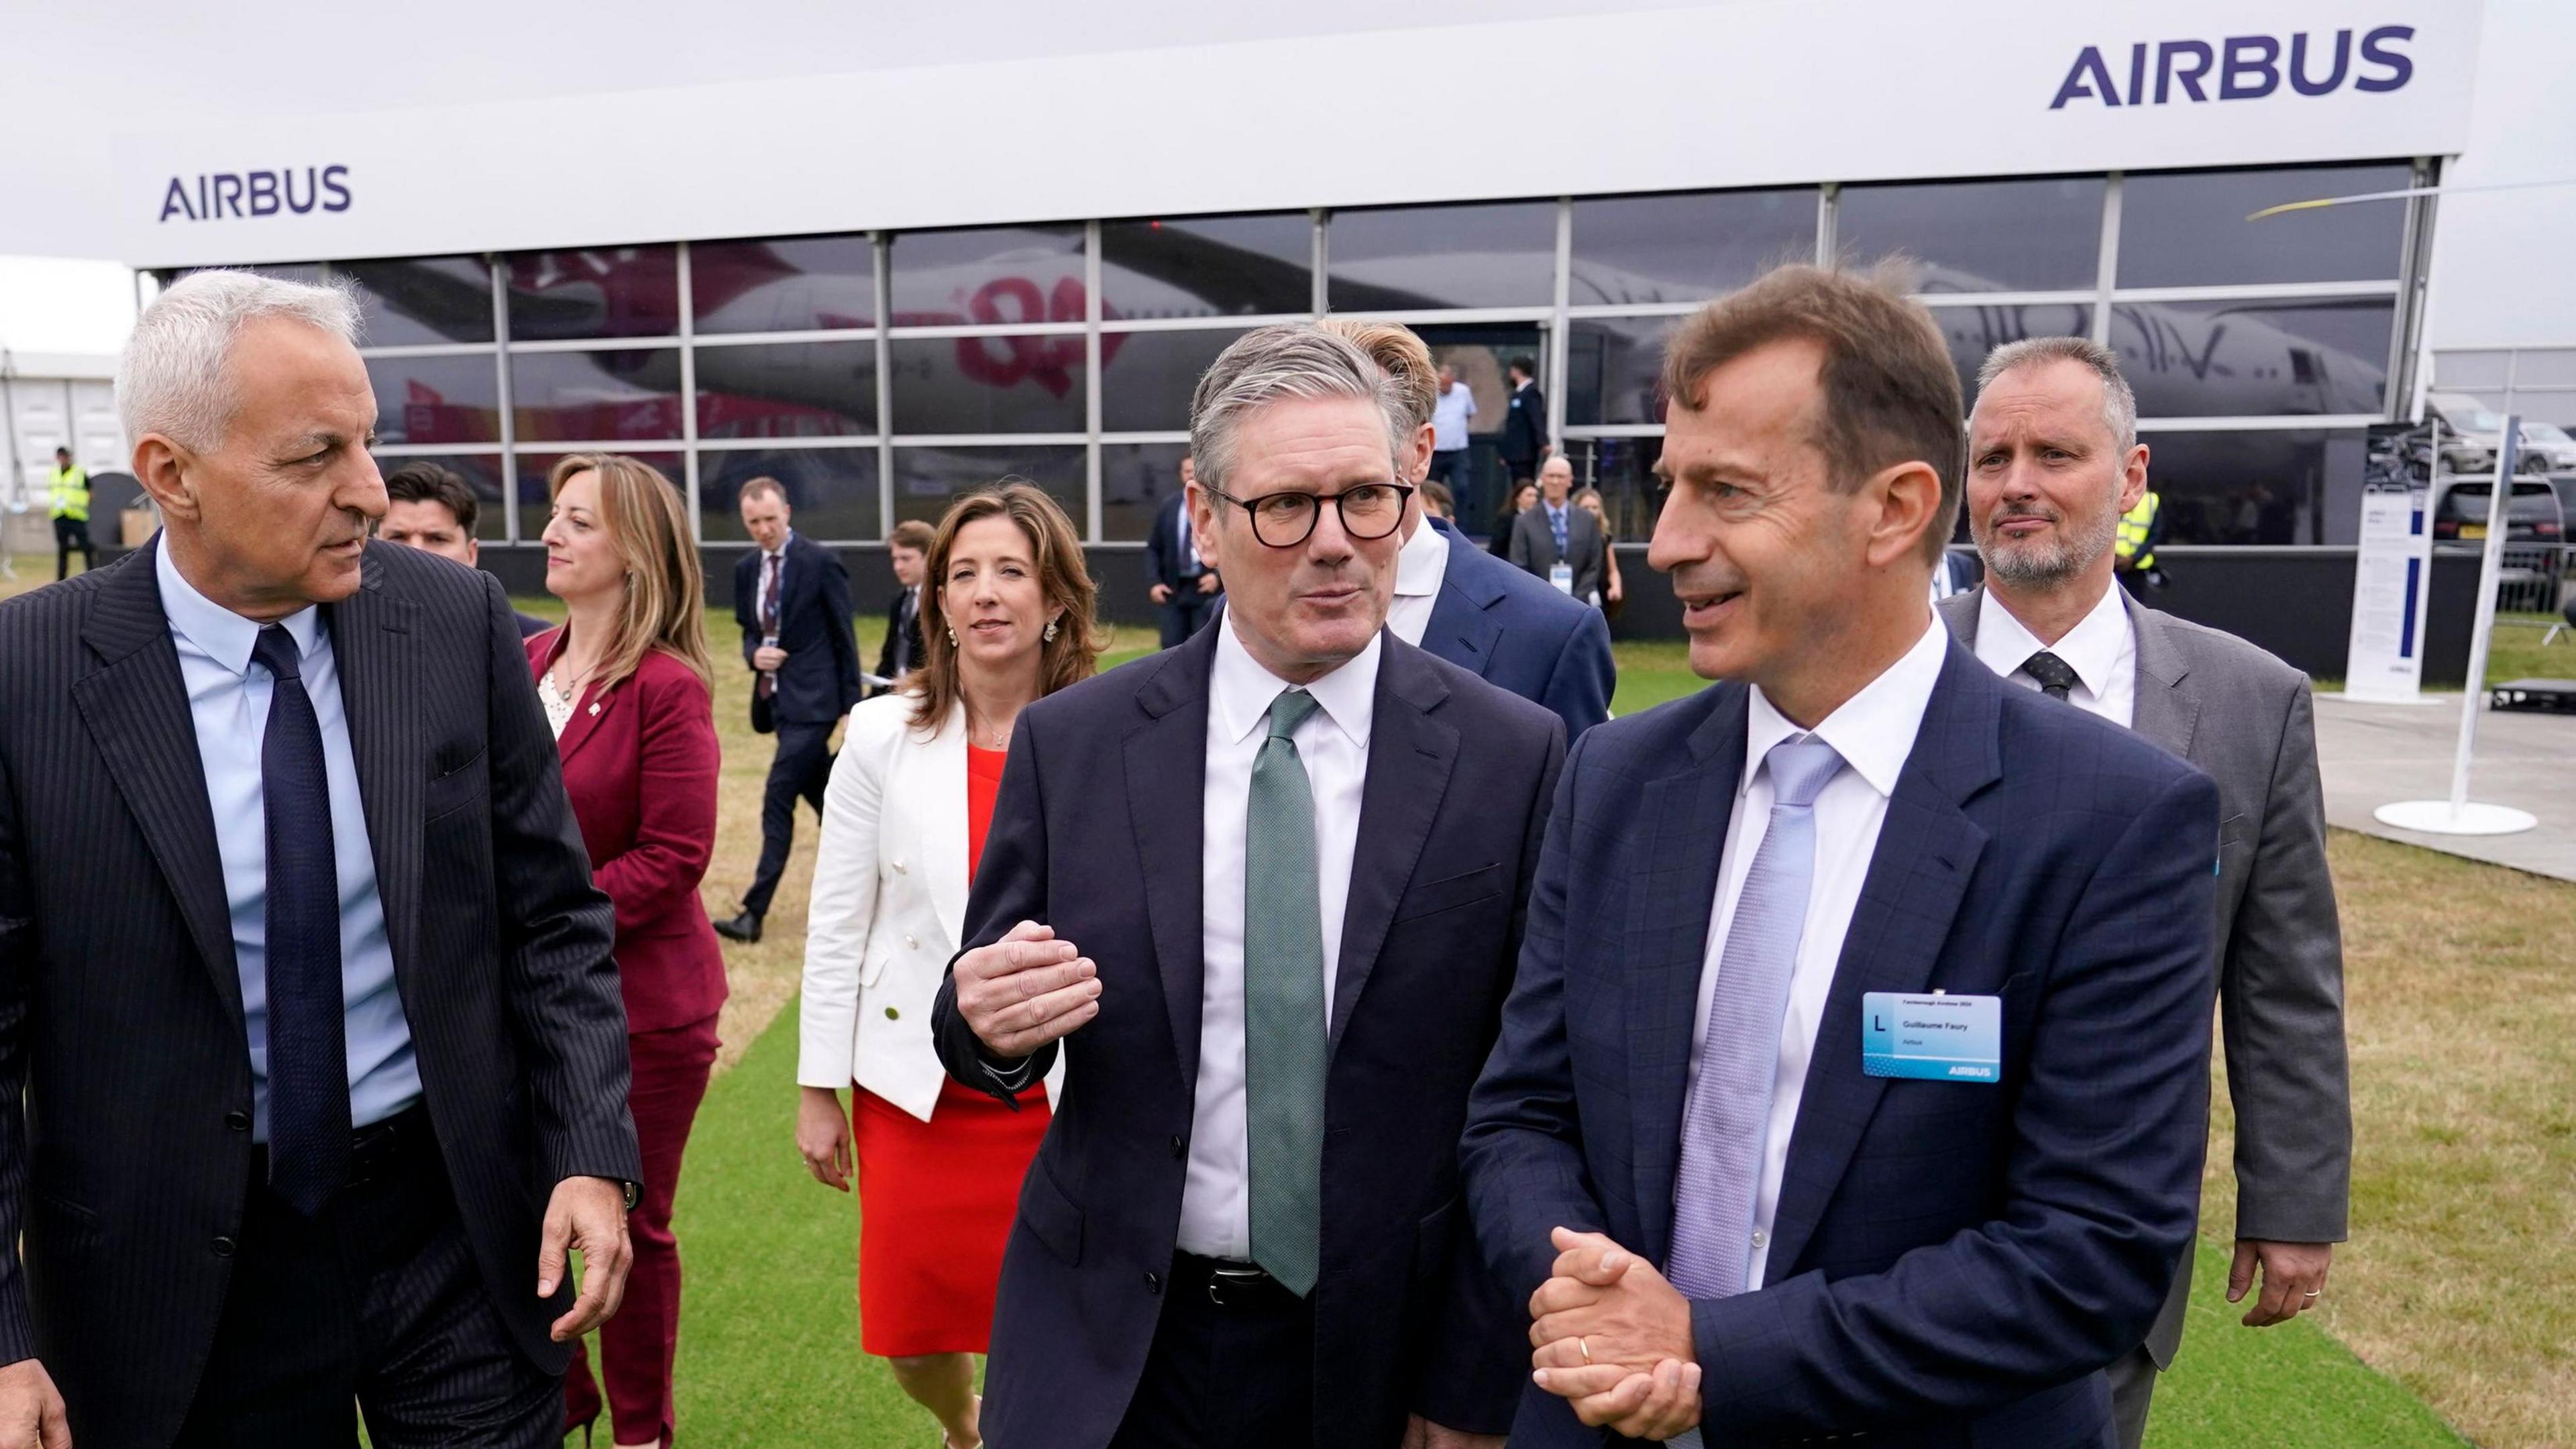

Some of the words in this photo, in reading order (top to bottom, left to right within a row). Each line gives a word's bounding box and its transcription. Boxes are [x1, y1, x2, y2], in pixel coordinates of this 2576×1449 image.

[2049, 25, 2415, 109] AIRBUS
[160, 166, 351, 221] AIRBUS
[1874, 1015, 1886, 1031] L
[1902, 1020, 1943, 1029] Guillaume
[1945, 1022, 1968, 1032] Faury
[1949, 1066, 1991, 1077] AIRBUS
